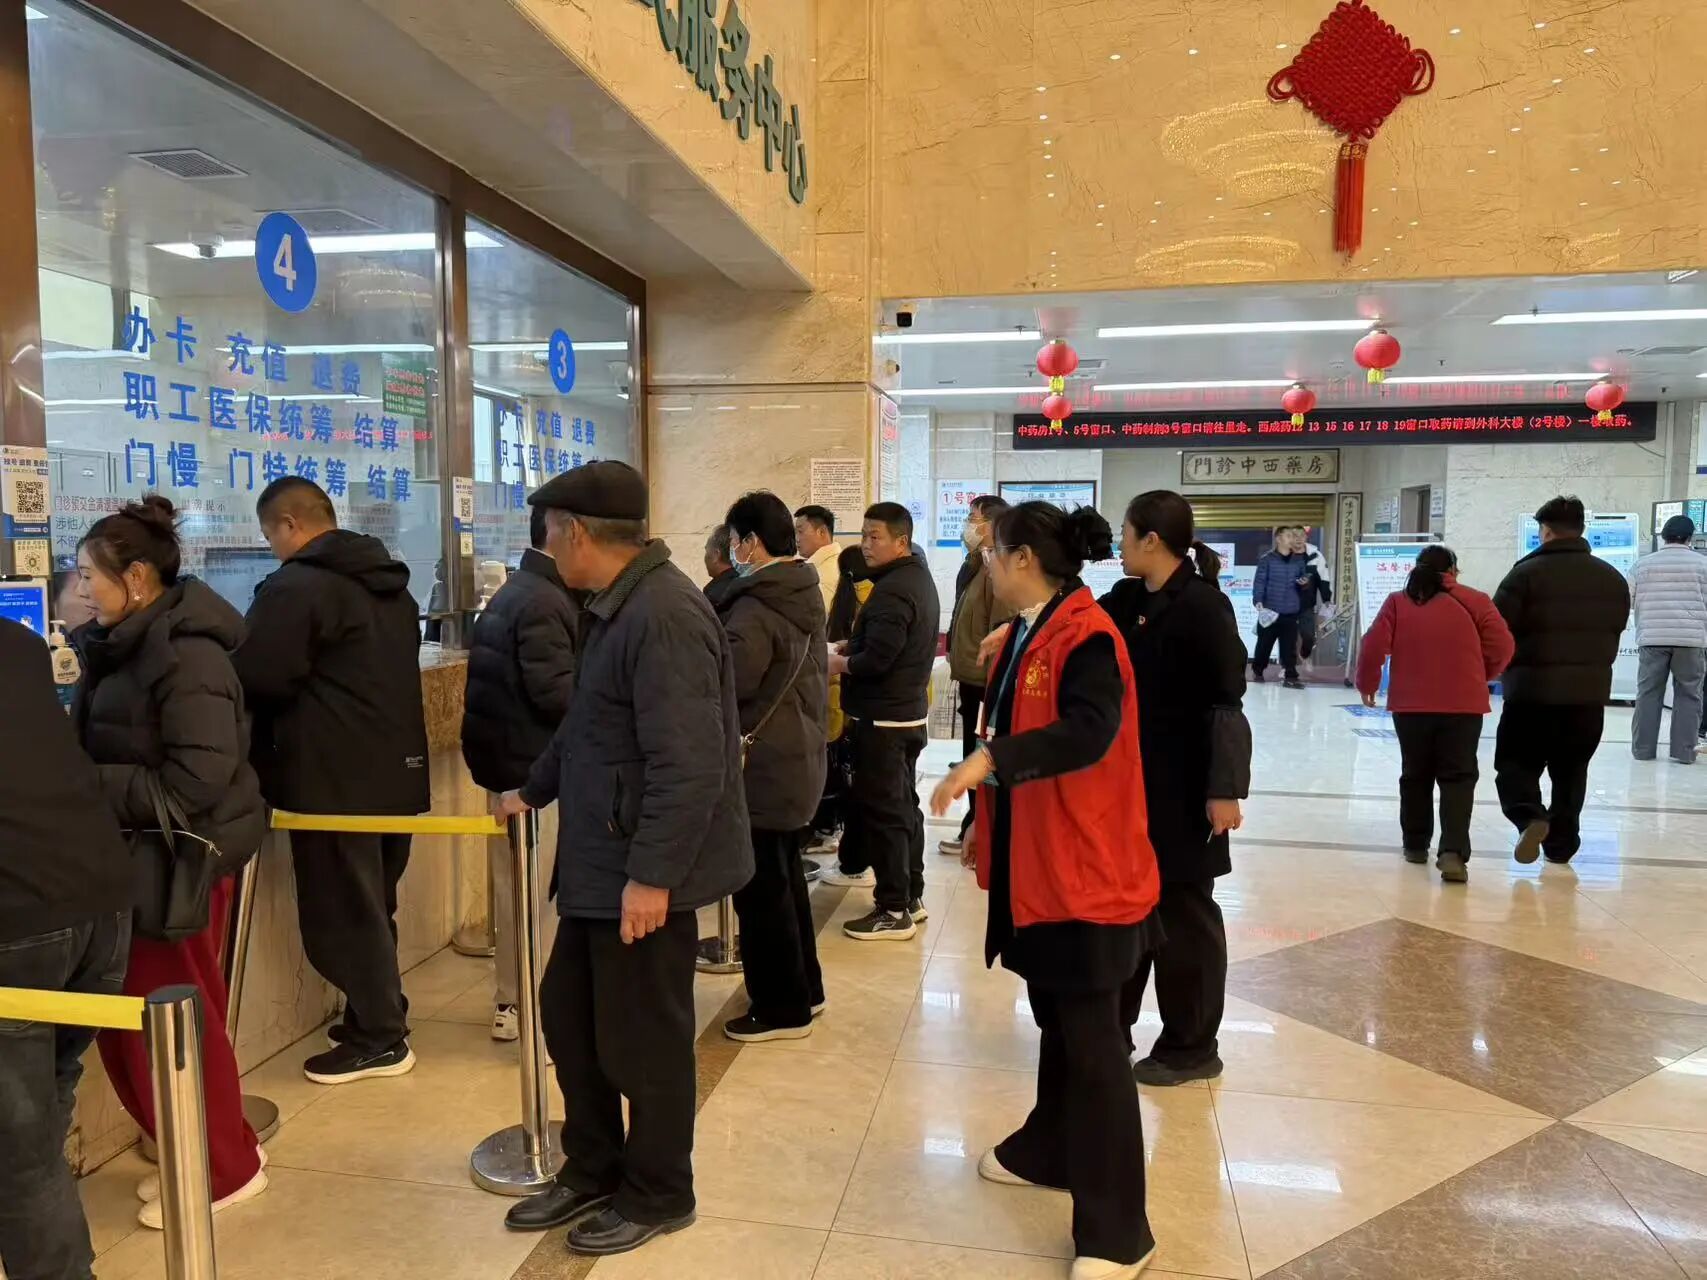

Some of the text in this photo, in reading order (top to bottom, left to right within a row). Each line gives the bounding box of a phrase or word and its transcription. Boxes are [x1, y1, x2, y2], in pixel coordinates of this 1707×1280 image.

[632, 0, 808, 205] 服务中心
[273, 233, 297, 291] 4
[122, 306, 197, 364] 办卡
[226, 332, 288, 382] 充值
[311, 352, 361, 397] 退费
[556, 340, 567, 380] 3
[123, 371, 334, 444] 职工医保统筹
[353, 412, 400, 452] 结算
[536, 407, 563, 439] 充值
[572, 416, 596, 447] 退费
[1308, 422, 1320, 432] 13
[1325, 421, 1337, 431] 15
[1342, 421, 1354, 431] 16
[1359, 421, 1372, 431] 17
[1376, 420, 1389, 431] 18
[124, 437, 412, 502] 门慢 门特统筹 结算
[1194, 456, 1324, 475] 門診中西藥房
[495, 479, 525, 509] 门慢
